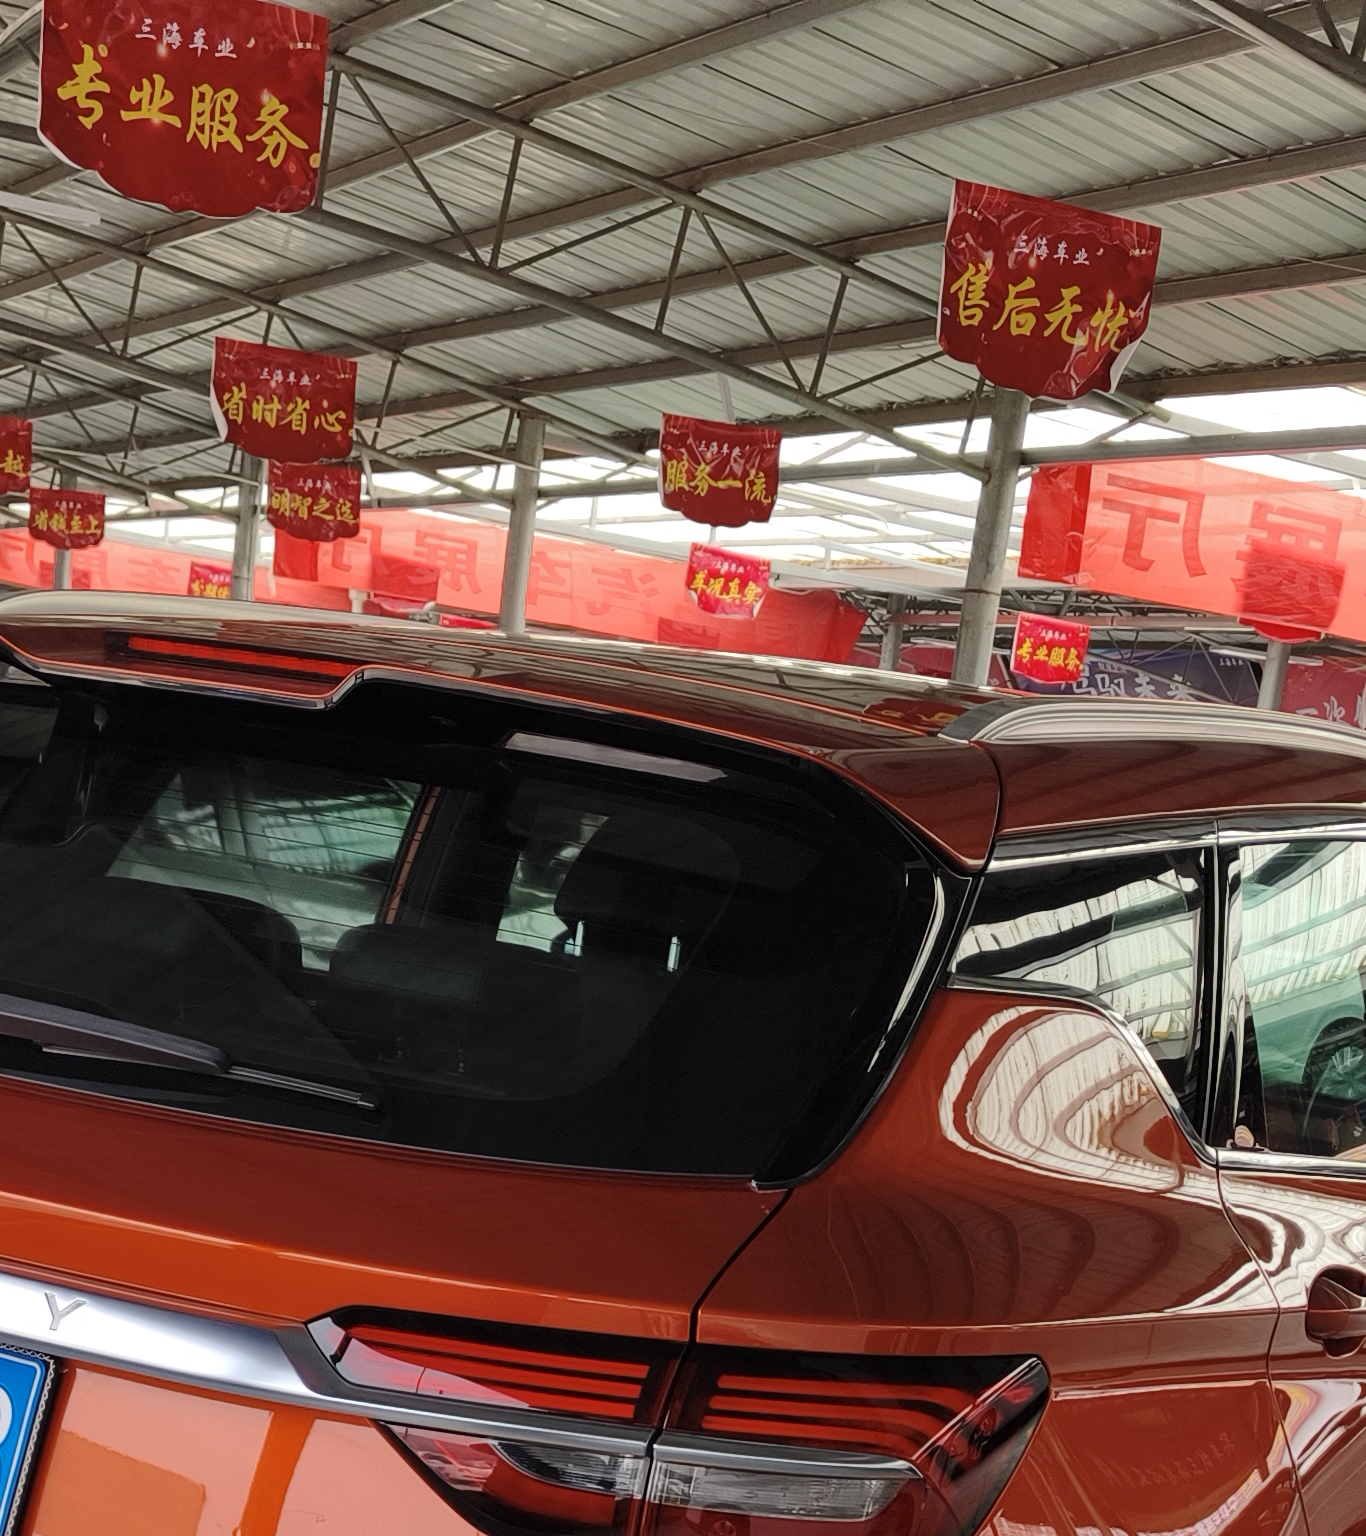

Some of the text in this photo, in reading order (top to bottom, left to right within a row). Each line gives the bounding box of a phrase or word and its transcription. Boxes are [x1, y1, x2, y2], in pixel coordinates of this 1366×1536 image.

[136, 18, 237, 58] 三海车业
[57, 44, 309, 168] 专业服务
[1013, 234, 1090, 265] 三海车业
[951, 262, 1135, 353] 售后无忧
[222, 382, 346, 435] 省时省心
[665, 459, 772, 503] 服务一流
[1017, 638, 1080, 669] 专业服务
